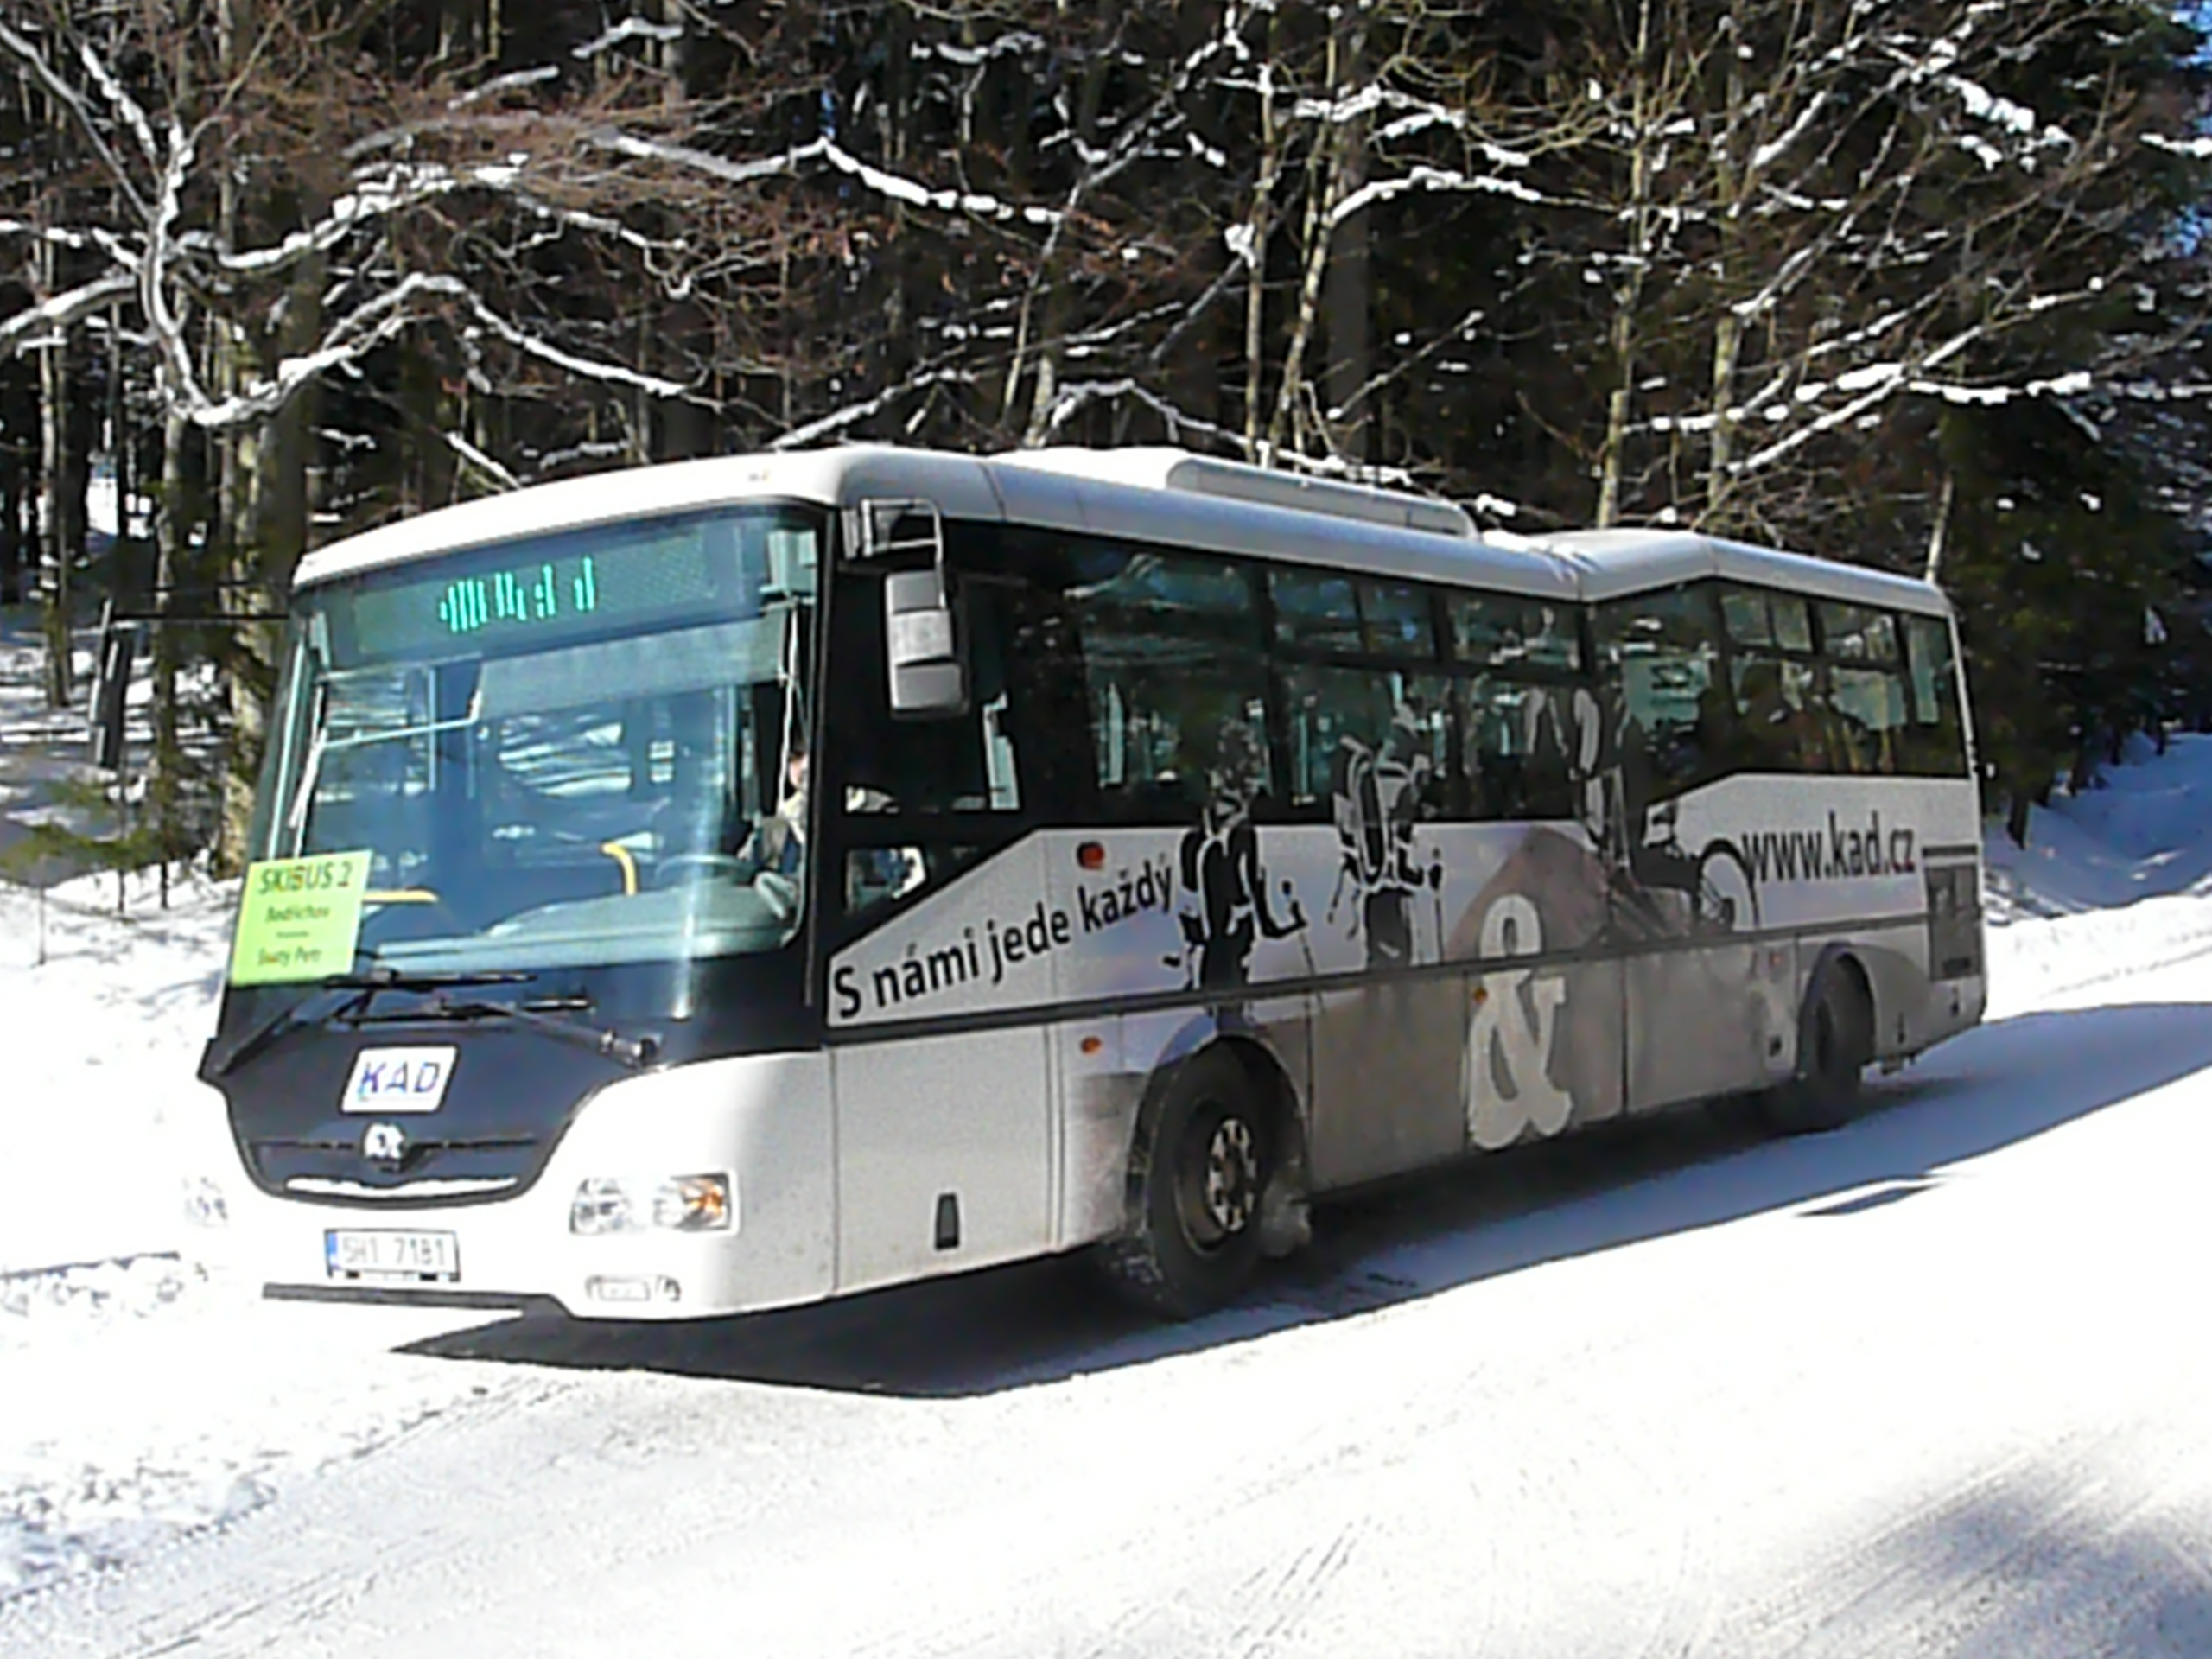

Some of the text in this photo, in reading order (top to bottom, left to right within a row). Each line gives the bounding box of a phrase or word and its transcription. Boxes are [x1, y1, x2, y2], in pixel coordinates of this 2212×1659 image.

[1742, 809, 1916, 882] www.kad.cz
[257, 861, 353, 895] SKIBUS 2
[834, 852, 1173, 1019] S námi jede každý
[358, 1061, 440, 1093] KAD
